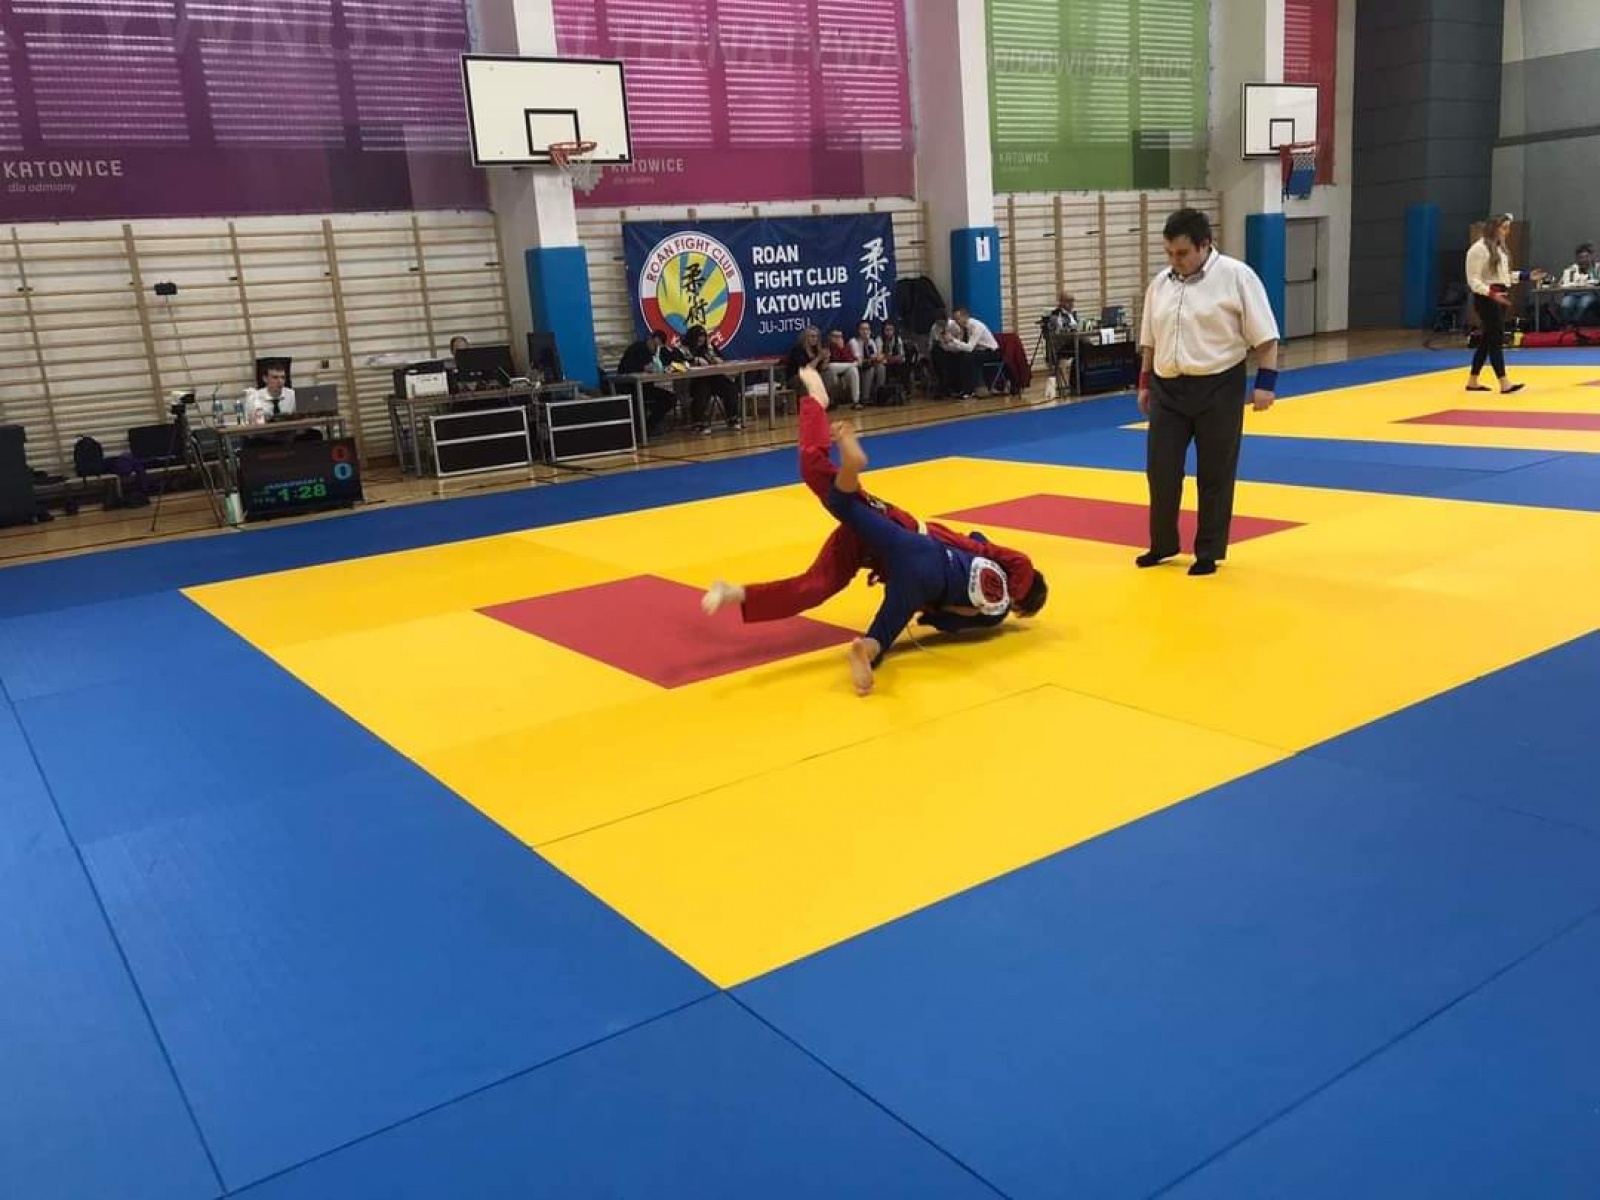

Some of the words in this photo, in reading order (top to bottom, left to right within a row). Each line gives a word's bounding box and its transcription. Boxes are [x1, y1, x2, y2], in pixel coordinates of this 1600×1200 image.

[3, 159, 124, 178] KATOWICE
[8, 181, 26, 193] dla
[646, 243, 675, 283] ROAN
[674, 237, 711, 253] FIGHT
[712, 248, 736, 280] CLUB
[752, 244, 799, 265] ROAN
[754, 268, 803, 290] FIGHT
[806, 265, 849, 286] CLUB
[756, 290, 842, 315] KATOWICE
[334, 462, 352, 480] 0
[278, 484, 327, 501] 1:28
